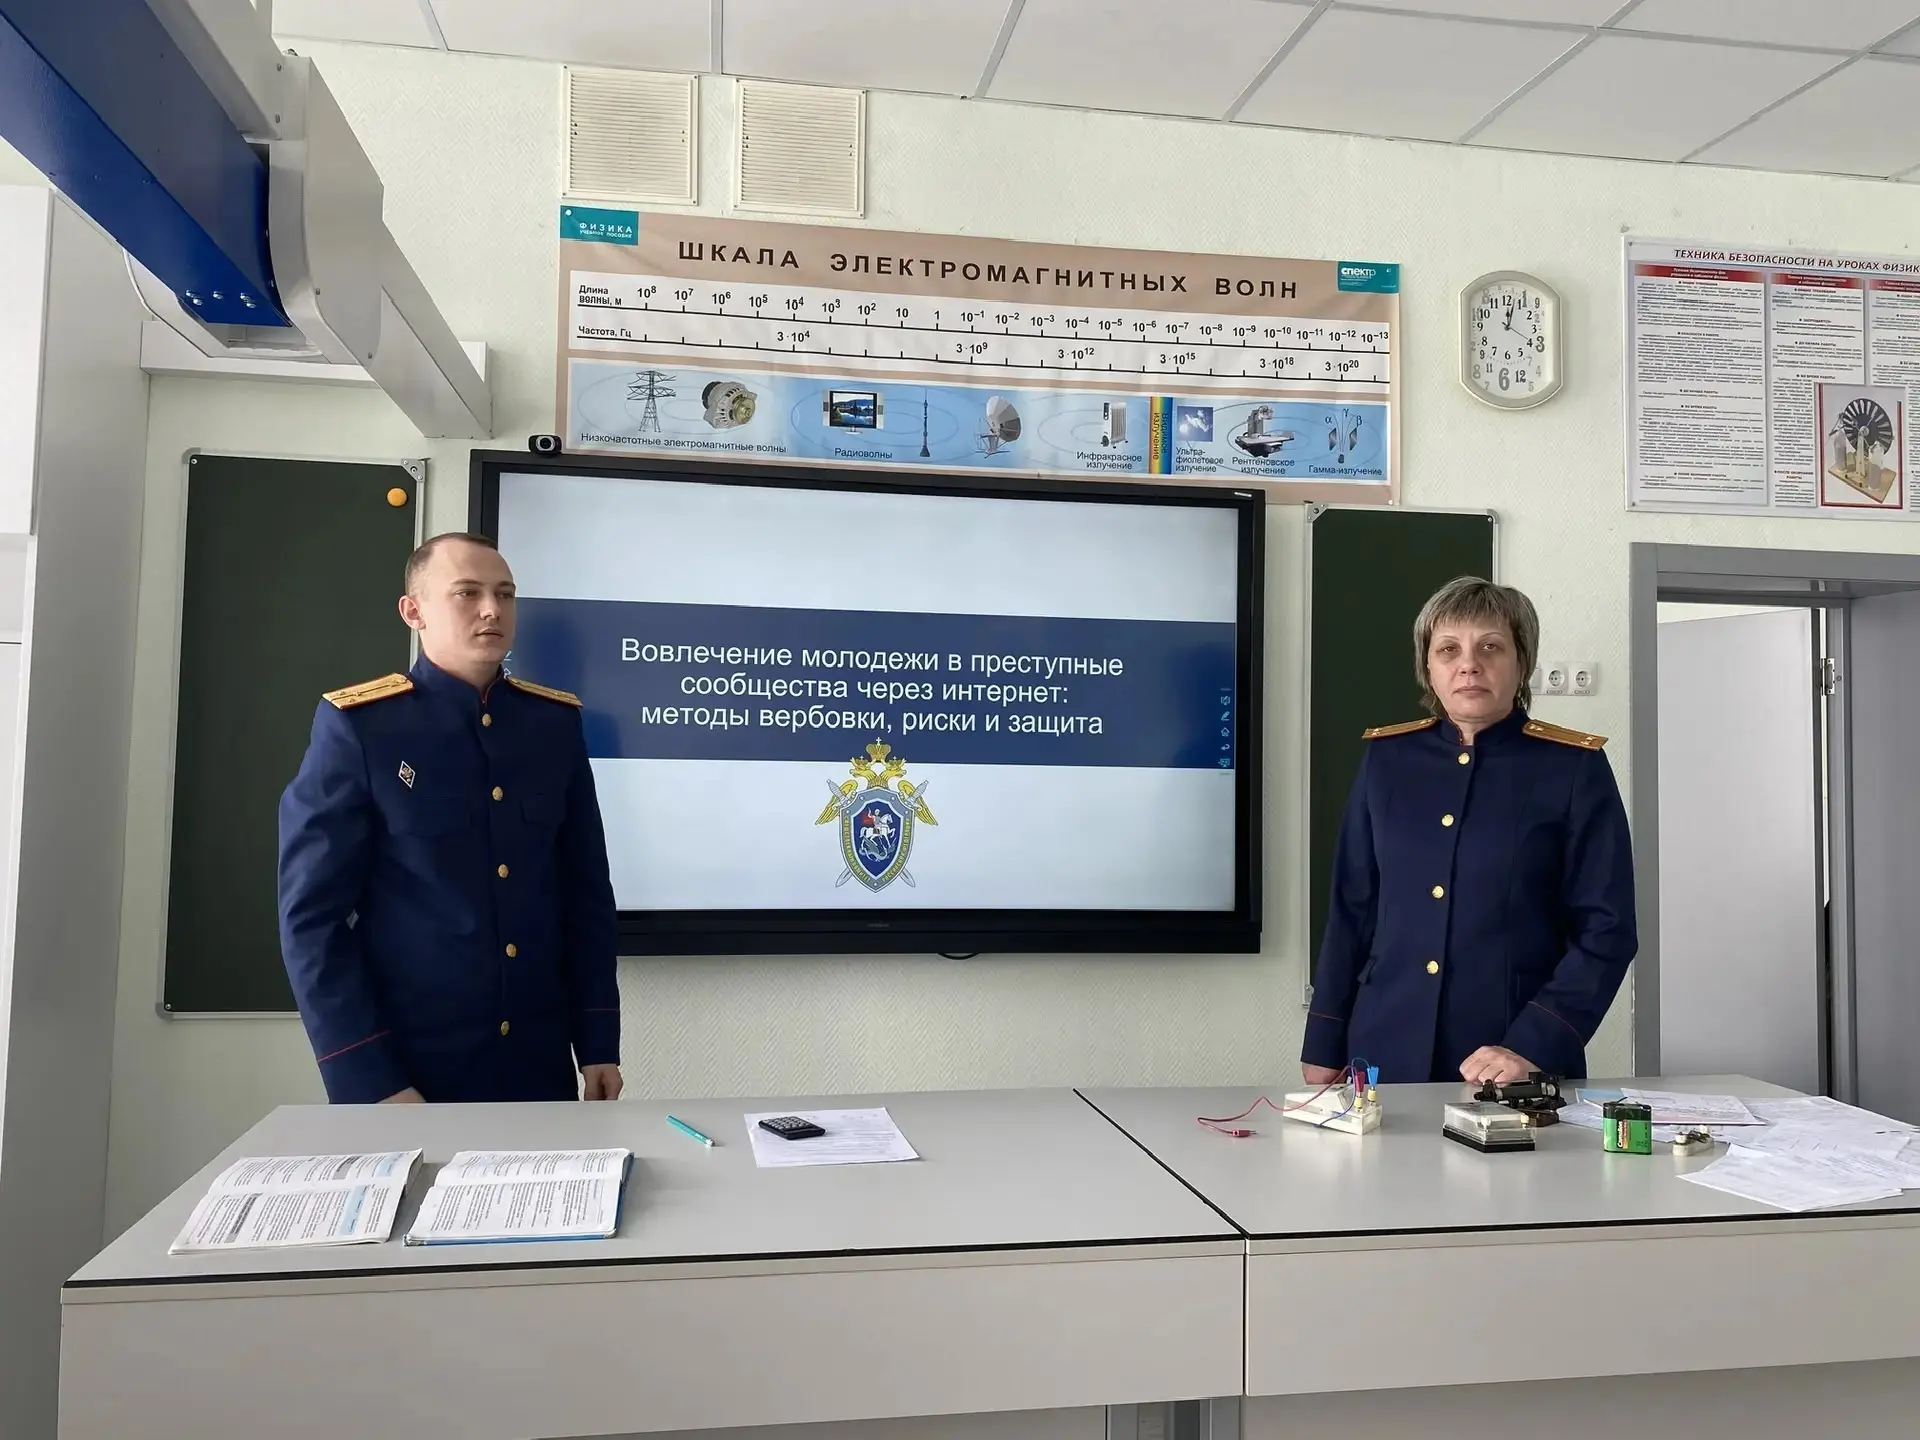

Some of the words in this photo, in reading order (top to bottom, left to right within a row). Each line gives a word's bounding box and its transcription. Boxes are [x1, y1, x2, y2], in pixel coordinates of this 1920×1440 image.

[580, 222, 632, 233] ФИЗИКА
[1674, 249, 1725, 260] ТЕХНИКА
[1729, 253, 1815, 266] БЕЗОПАСНОСТИ
[1819, 259, 1833, 268] НА
[1837, 260, 1879, 271] УРОКАХ
[679, 241, 799, 268] ШКАЛА
[830, 253, 1187, 293] ЭЛЕКТРОМАГНИТНЫХ
[1215, 277, 1297, 299] ВОЛН
[579, 285, 609, 294] Длина
[579, 295, 612, 306] волны,
[1490, 298, 1499, 309] 11
[1502, 295, 1512, 306] 12
[1518, 299, 1522, 310] 1
[896, 308, 909, 318] 10
[934, 310, 940, 320] 1
[1480, 308, 1490, 319] 10
[1526, 310, 1533, 320] 2
[578, 325, 618, 337] Частота,
[620, 328, 632, 338] Гц
[1477, 322, 1484, 331] 9
[1531, 324, 1537, 334] 3
[1481, 336, 1488, 346] 8
[1526, 338, 1533, 348] 4
[1535, 335, 1545, 353] 3
[1491, 346, 1498, 356] 7
[1504, 350, 1512, 360] 6
[1517, 347, 1524, 357] 5
[1498, 367, 1510, 391] 6
[1515, 369, 1527, 383] 12
[581, 433, 661, 446] Низкочастотные
[664, 438, 754, 451] электромагнитные
[757, 444, 786, 453] волны
[835, 448, 893, 459] Радиоволны
[1076, 451, 1142, 463] Инфракрасное
[1176, 447, 1205, 456] Ультра-
[1086, 461, 1132, 471] излучение
[1175, 456, 1224, 465] фиолетовое
[1232, 457, 1295, 468] Рентгеновское
[1175, 464, 1217, 474] излучение
[1241, 466, 1286, 476] излучение
[1308, 464, 1383, 476] Гамма-излучение
[621, 637, 793, 666] Вовлечение
[802, 649, 939, 673] молодежи
[948, 654, 962, 671] в
[971, 654, 1124, 680] преступные
[681, 672, 848, 700] сообщества
[857, 681, 933, 704] через
[942, 683, 1069, 707] интернет:
[641, 705, 749, 730] методы
[759, 705, 893, 733] вербовки,
[902, 711, 976, 735] риски
[985, 715, 1000, 731] и
[1008, 714, 1104, 737] защита
